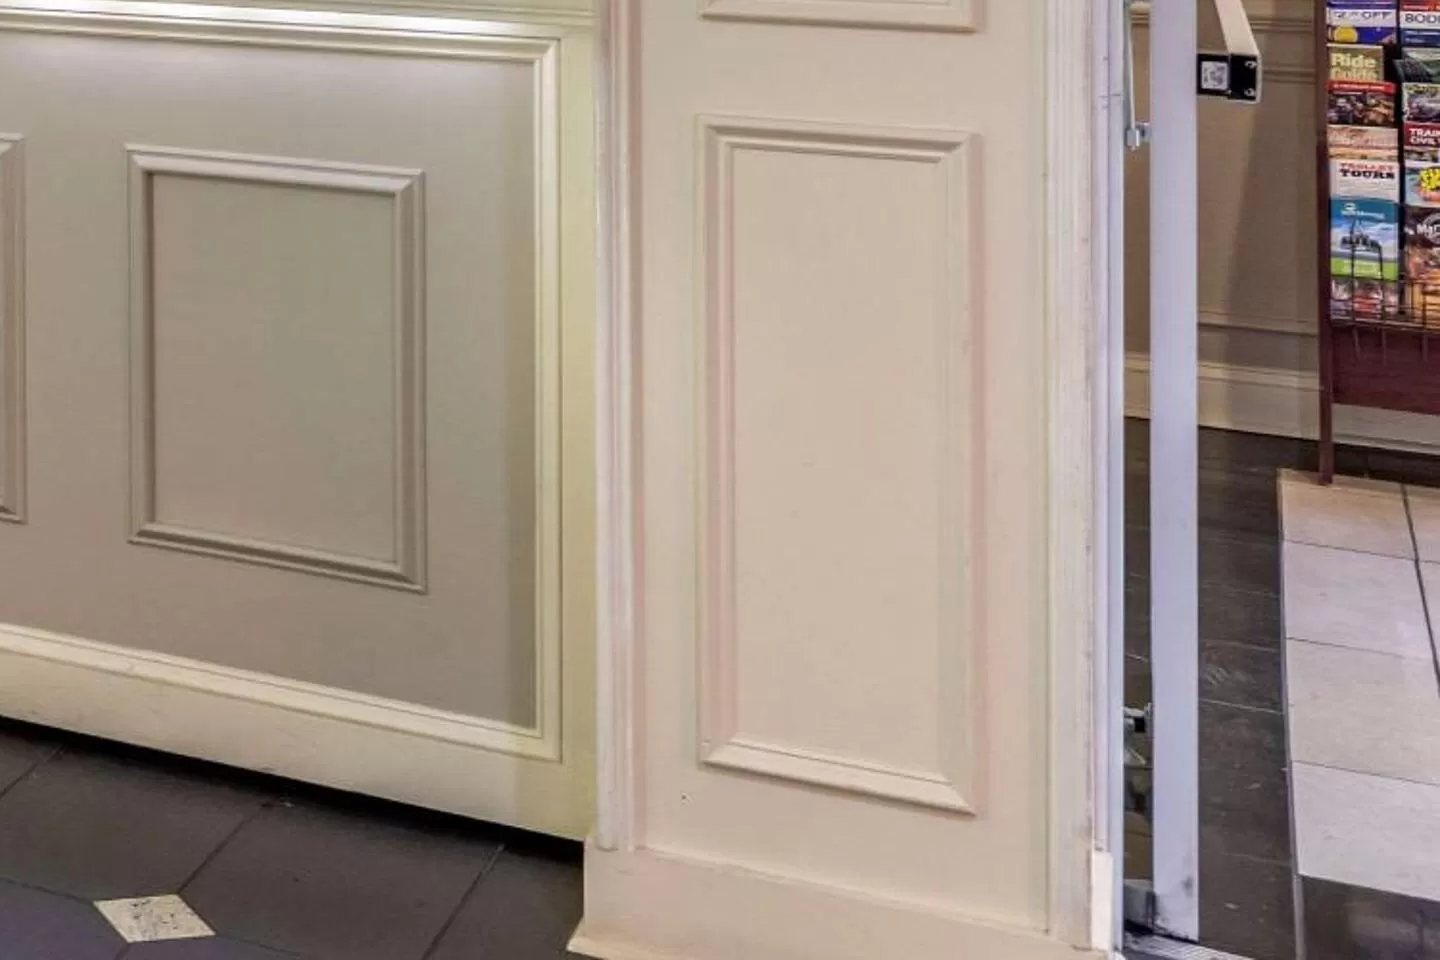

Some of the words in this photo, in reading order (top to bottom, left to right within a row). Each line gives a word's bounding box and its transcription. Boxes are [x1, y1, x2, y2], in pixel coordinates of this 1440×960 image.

[1331, 52, 1376, 68] Ride
[1330, 68, 1378, 80] Guide
[1339, 169, 1396, 179] TOURS
